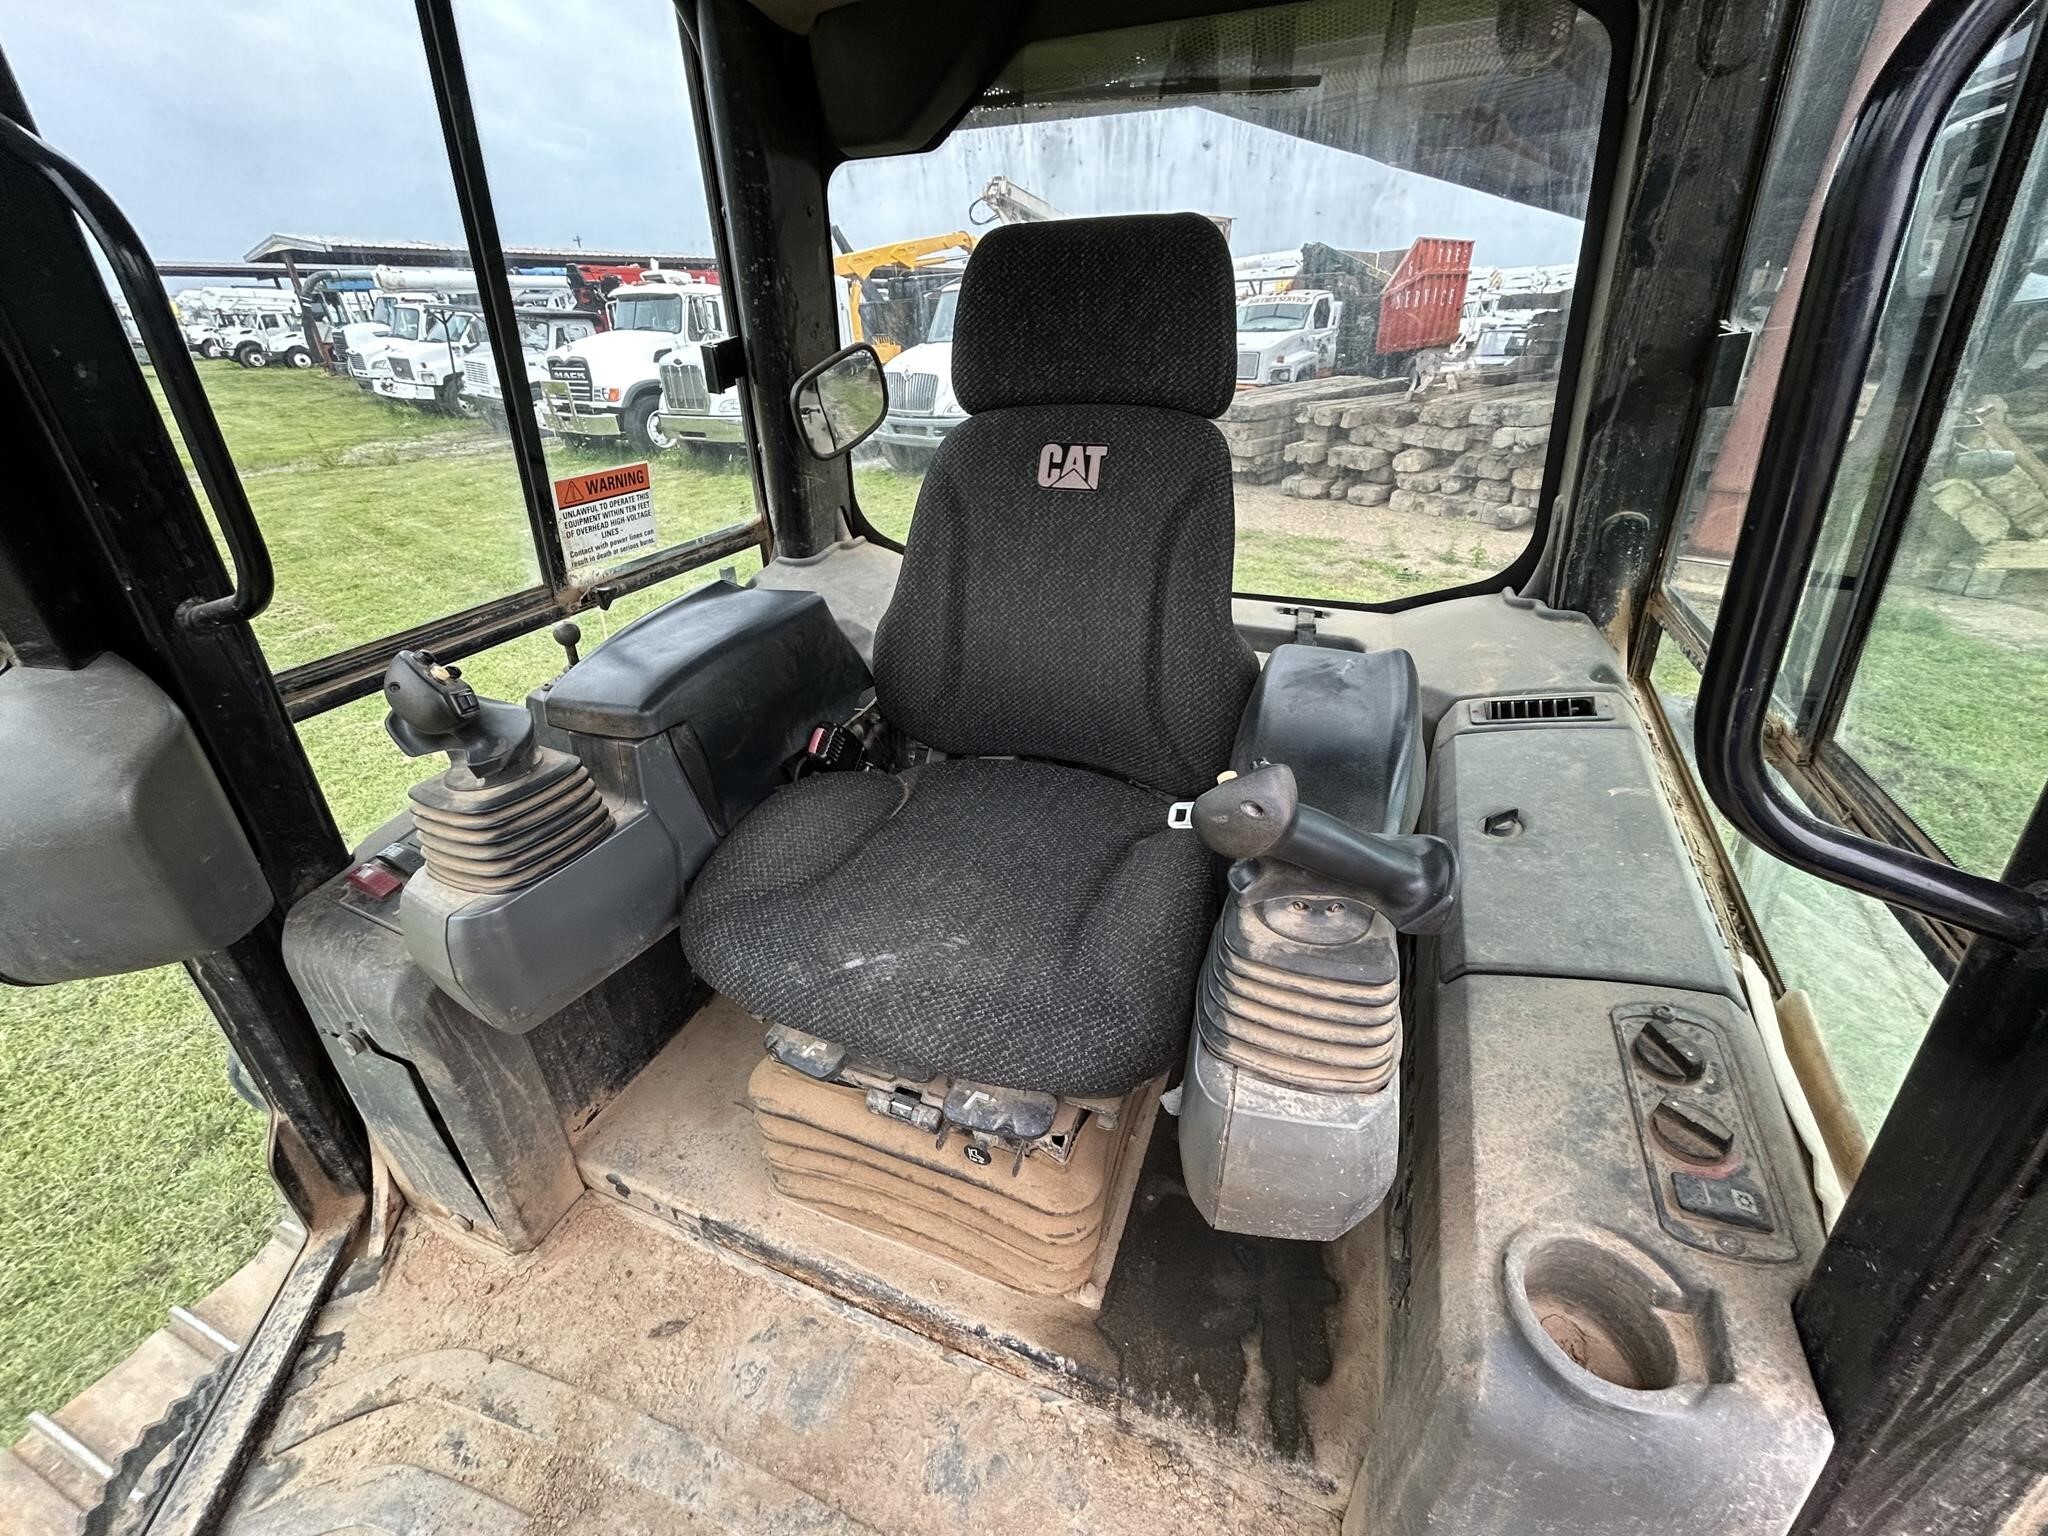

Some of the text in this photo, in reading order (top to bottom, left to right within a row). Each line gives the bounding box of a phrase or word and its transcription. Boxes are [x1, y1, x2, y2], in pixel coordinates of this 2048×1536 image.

[1395, 287, 1455, 310] SERVICE
[554, 371, 586, 380] MACK
[1038, 443, 1108, 490] CAT
[585, 470, 645, 496] WARNING
[562, 491, 650, 520] UNLAWFUL TO OPERATE THIS
[564, 500, 650, 529] EQUIPMENT WITHIN TEN FEET
[566, 529, 575, 539] OF
[576, 521, 609, 536] OVERHEAD
[570, 528, 655, 558] Contact with power lines can
[601, 527, 619, 539] LINES
[571, 556, 589, 568] result
[589, 554, 596, 562] in
[597, 549, 613, 560] death
[620, 542, 639, 553] serious
